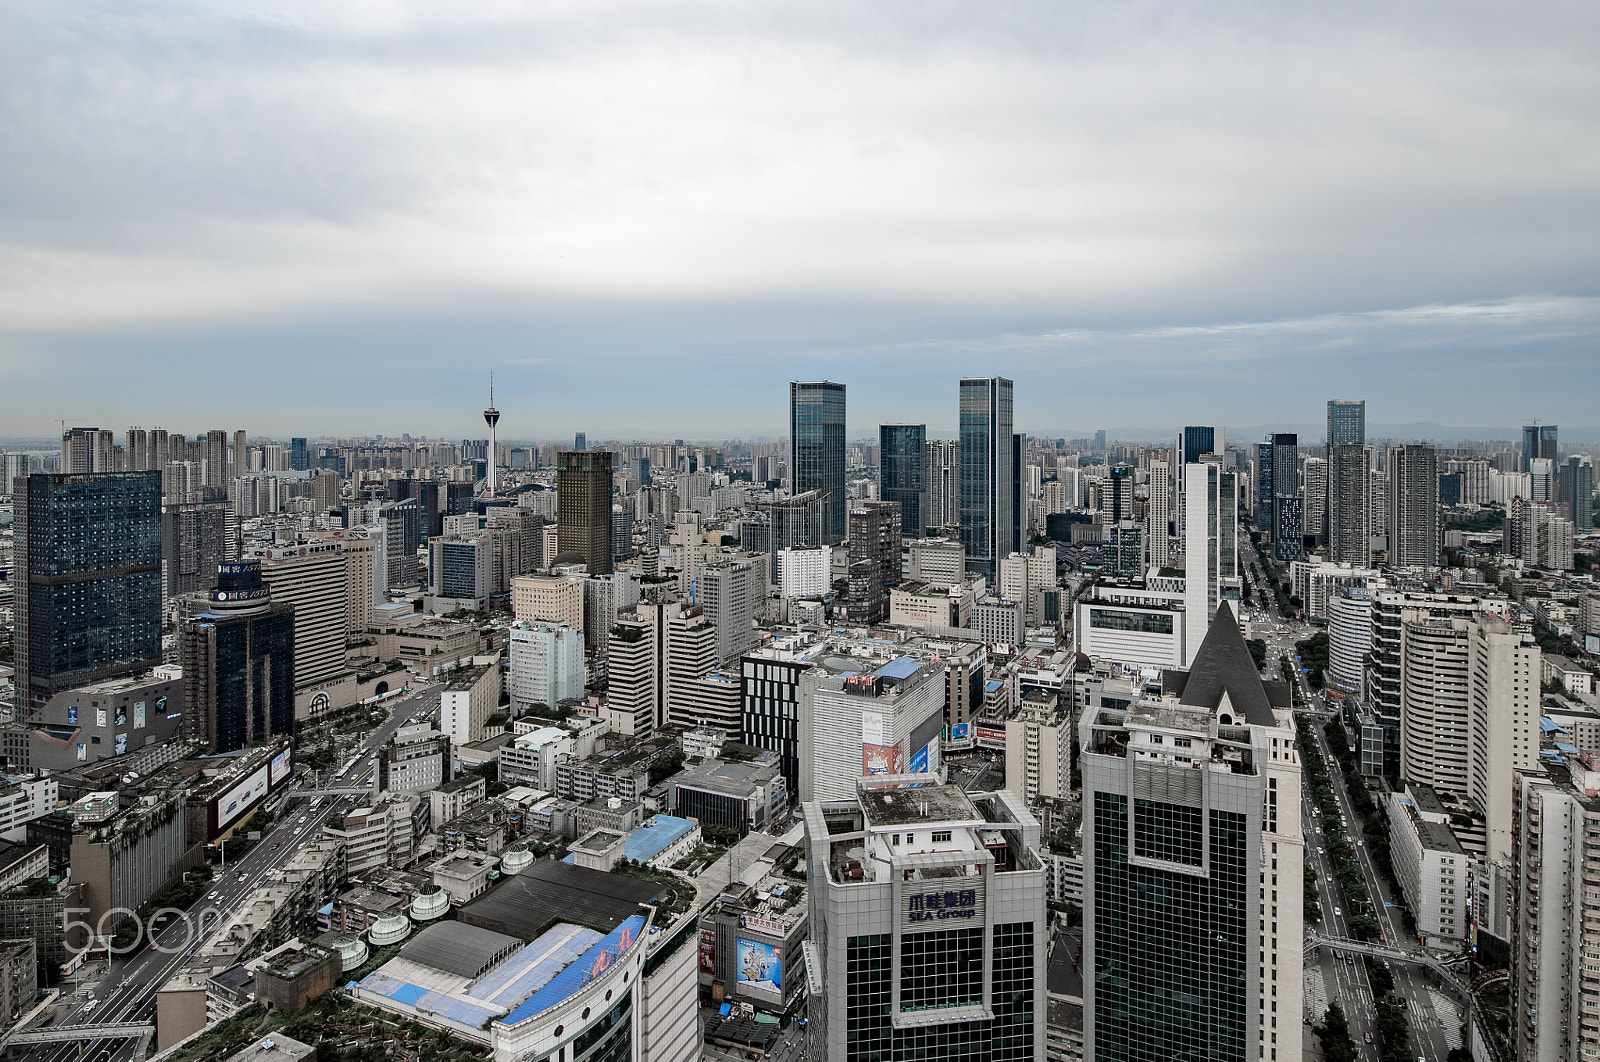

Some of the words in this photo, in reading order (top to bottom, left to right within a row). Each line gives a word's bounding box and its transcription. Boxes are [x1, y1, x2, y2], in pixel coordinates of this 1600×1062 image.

[283, 549, 297, 557] ICBC
[249, 588, 270, 598] 1573
[908, 911, 934, 922] SEA
[937, 908, 976, 920] Group
